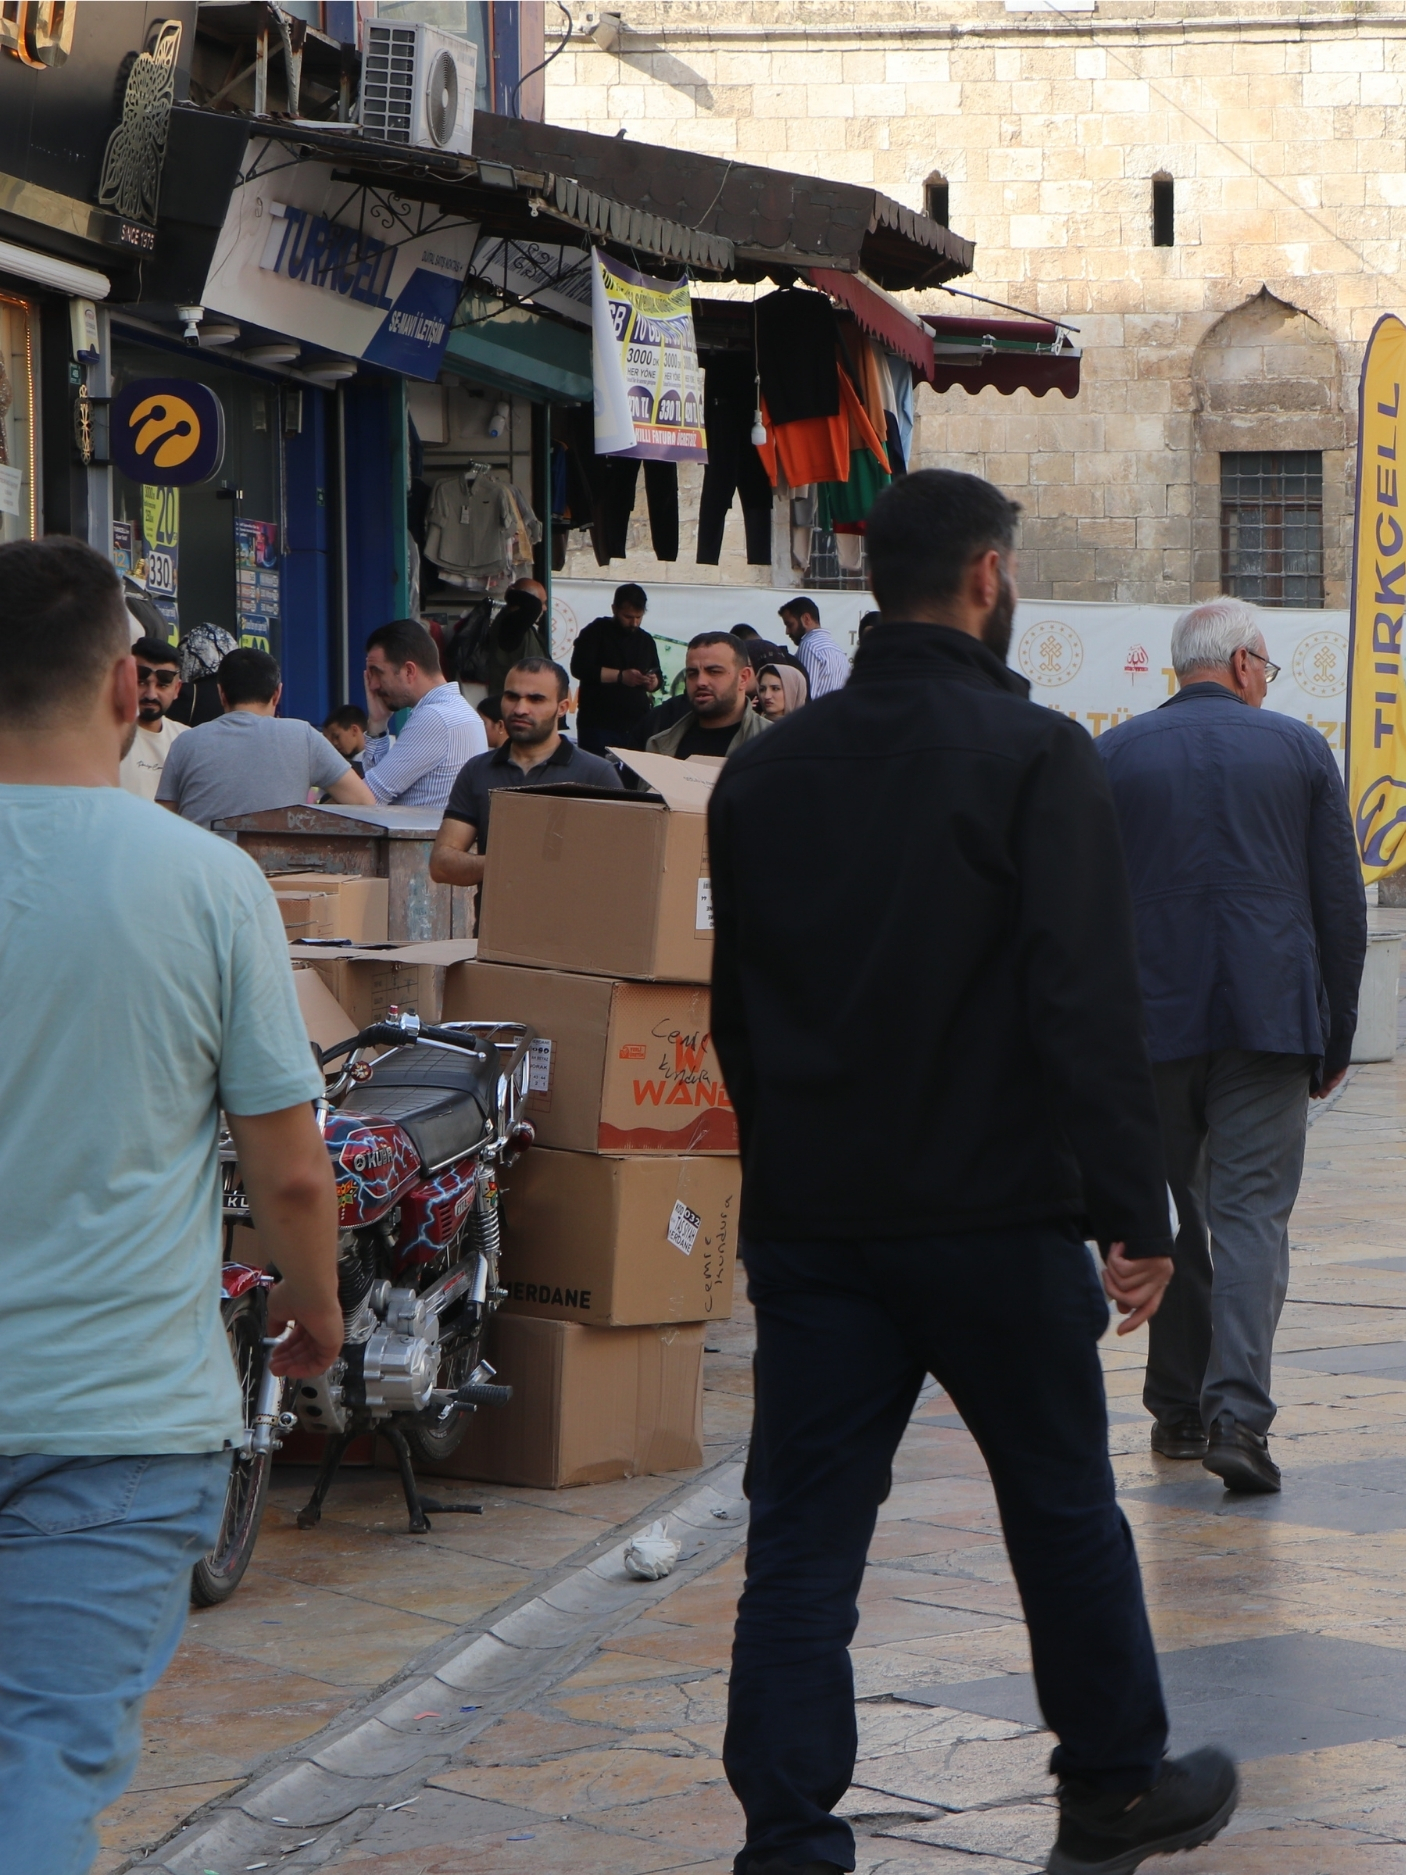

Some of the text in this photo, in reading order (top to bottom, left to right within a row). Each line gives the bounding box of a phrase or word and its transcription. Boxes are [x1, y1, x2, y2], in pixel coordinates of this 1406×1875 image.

[121, 224, 155, 250] SINCE 1975
[264, 202, 398, 312] TURKCELL
[626, 348, 653, 365] 3000
[627, 368, 656, 379] HER YÖNE
[640, 397, 650, 419] TL
[659, 399, 675, 421] 330
[652, 429, 676, 446] FATURA
[150, 554, 171, 588] 330
[367, 1147, 393, 1169] KUBA
[684, 1209, 700, 1227] 032
[669, 1230, 692, 1253] ERDANE
